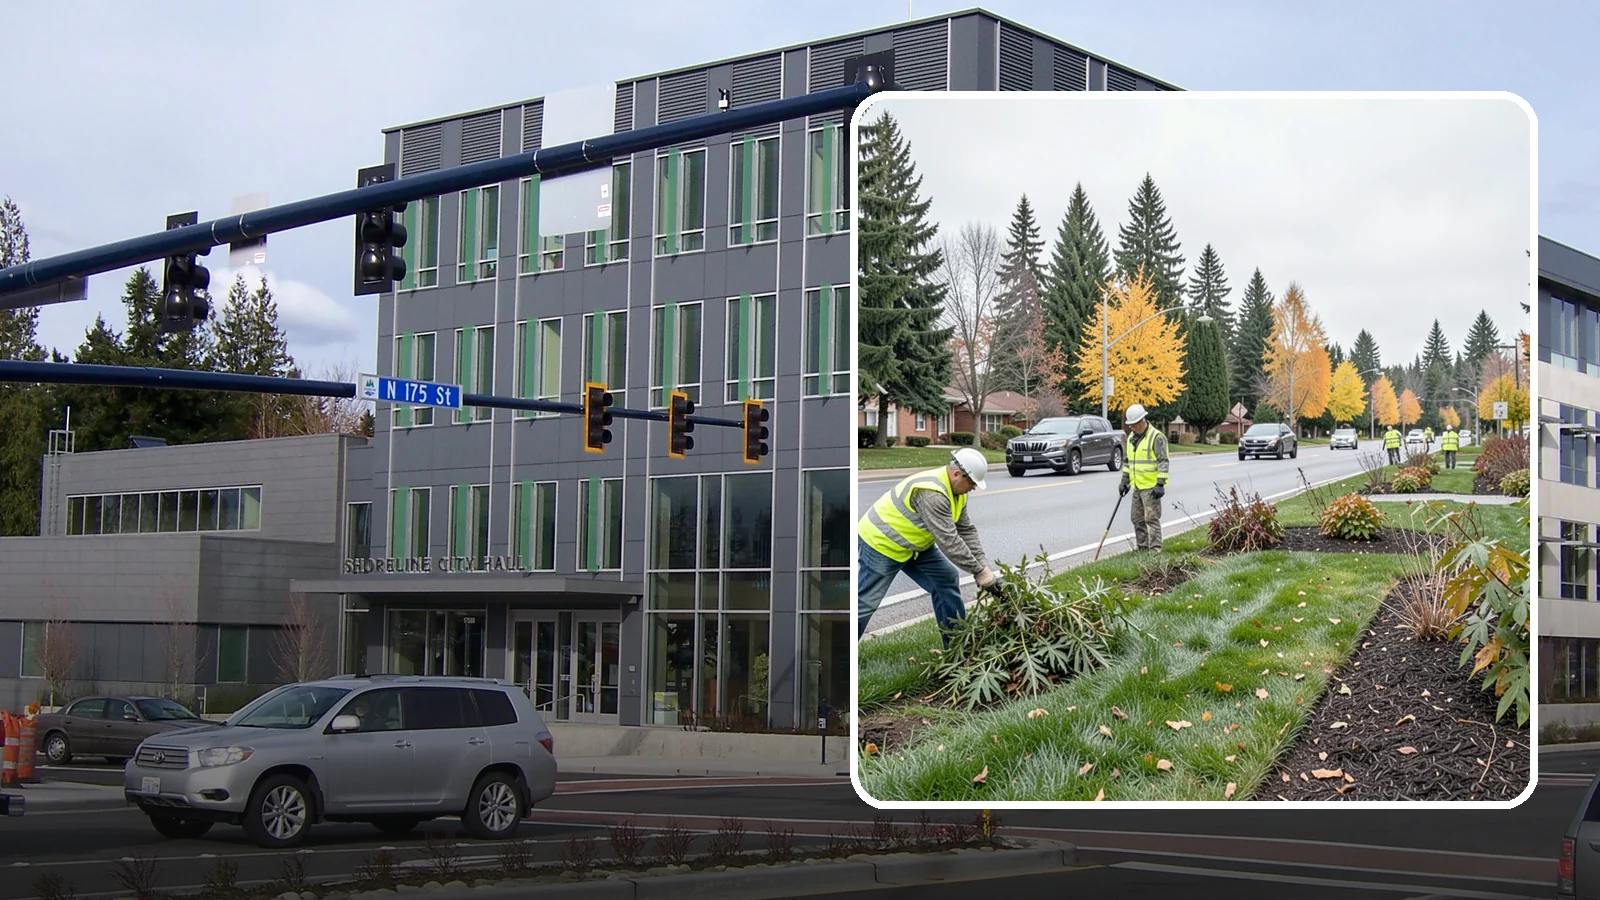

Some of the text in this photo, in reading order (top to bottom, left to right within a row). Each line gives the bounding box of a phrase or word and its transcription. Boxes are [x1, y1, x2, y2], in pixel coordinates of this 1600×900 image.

[387, 381, 452, 406] N 175 St
[344, 555, 526, 574] SHORELINE CITY HALL
